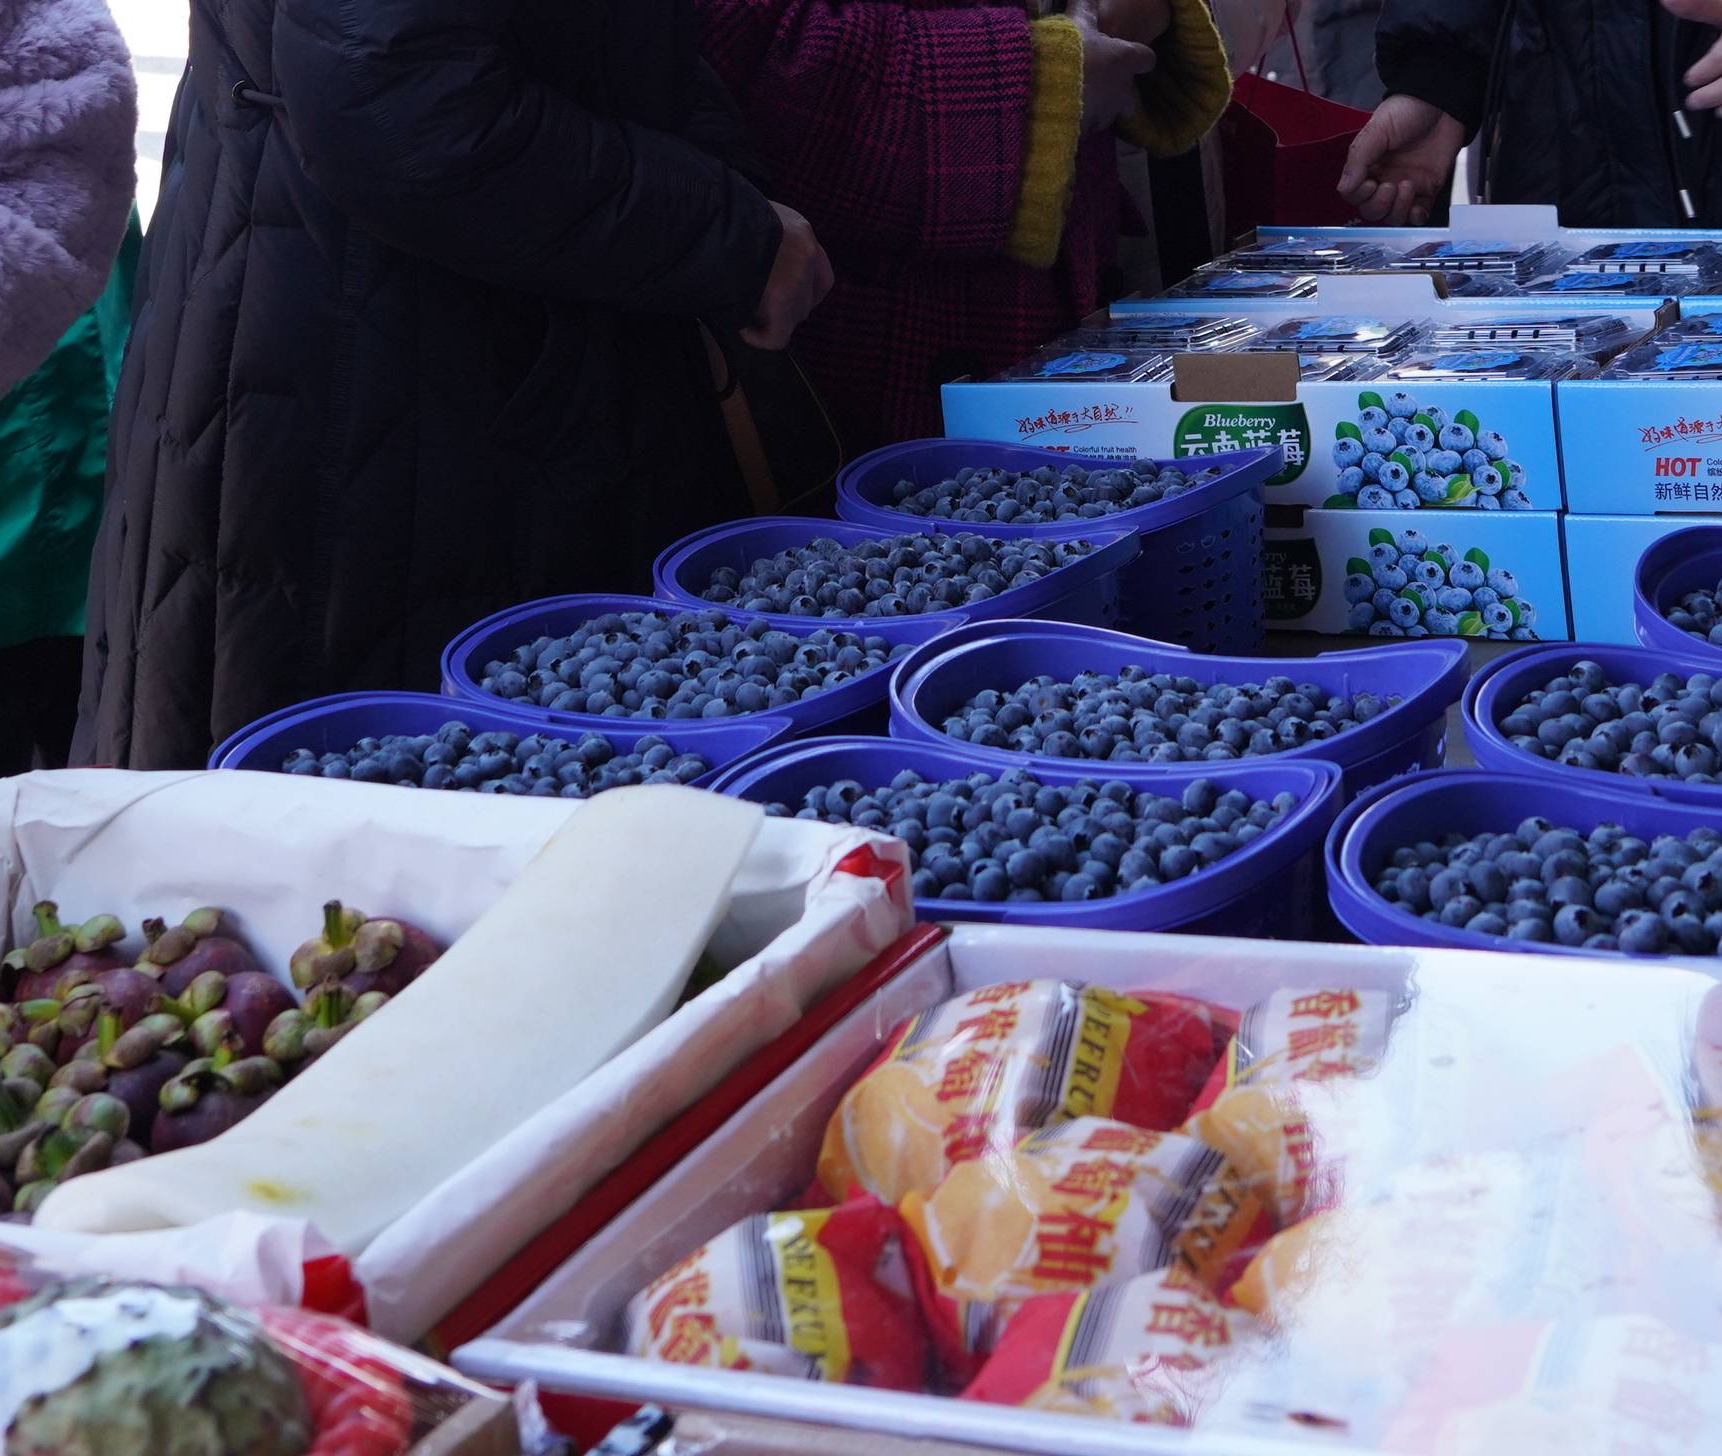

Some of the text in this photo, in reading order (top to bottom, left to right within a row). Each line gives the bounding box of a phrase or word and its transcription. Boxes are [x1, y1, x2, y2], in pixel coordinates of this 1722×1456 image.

[1203, 413, 1277, 430] Blueberry
[1073, 446, 1100, 454] Colorful
[1654, 457, 1703, 477] HOT
